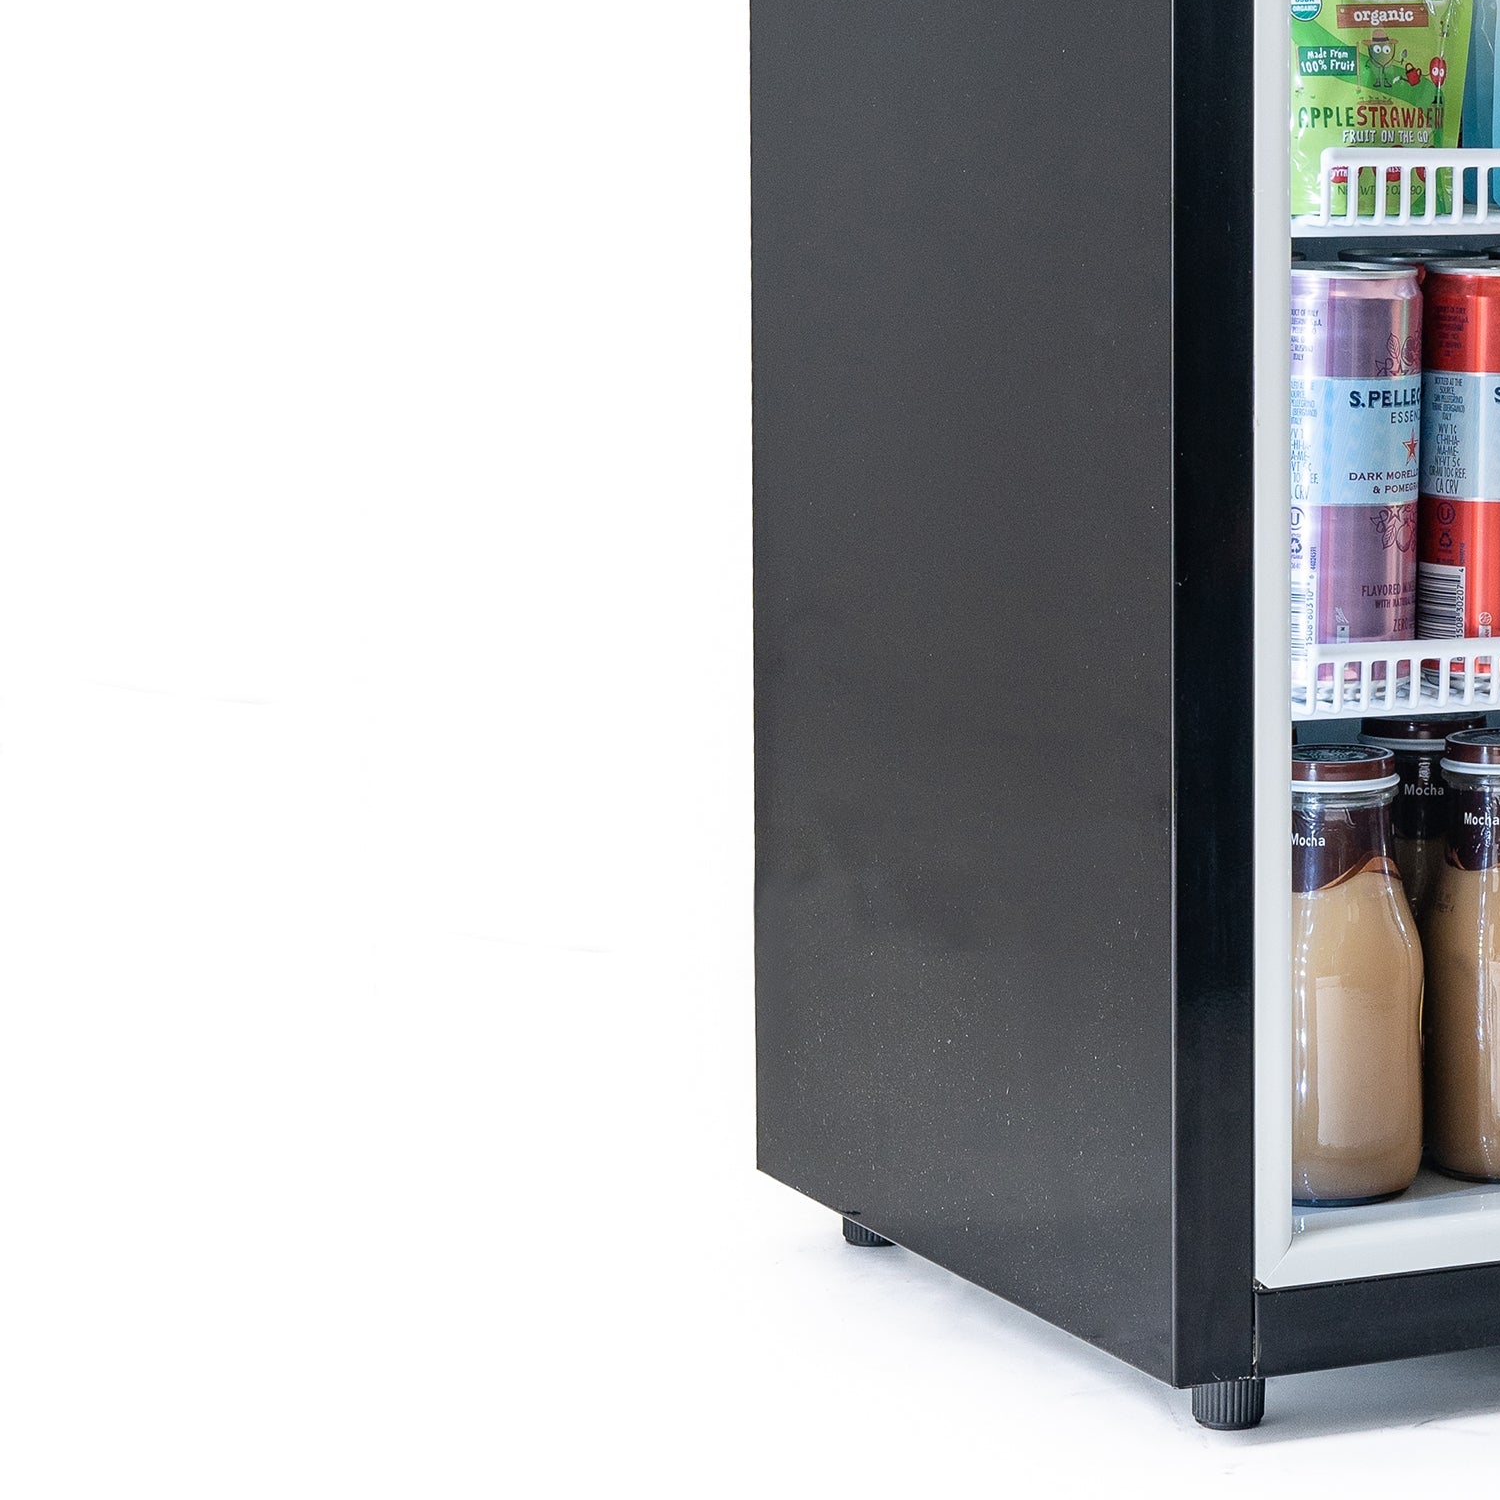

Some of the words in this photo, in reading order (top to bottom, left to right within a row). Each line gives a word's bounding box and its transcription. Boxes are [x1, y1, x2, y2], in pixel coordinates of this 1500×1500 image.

[1354, 8, 1414, 26] organic
[1308, 48, 1327, 60] Made
[1330, 49, 1348, 59] From
[1300, 60, 1327, 73] 100%
[1330, 59, 1355, 72] Fruit
[1342, 130, 1376, 144] FRUIT
[1381, 130, 1394, 143] ON
[1398, 130, 1414, 144] THE
[1417, 130, 1428, 144] GO
[1349, 472, 1382, 480] DARK
[1372, 486, 1380, 494] &
[1436, 478, 1444, 492] CA
[1446, 479, 1459, 494] CRV
[1362, 583, 1400, 596] FLAVORED
[1456, 584, 1464, 613] 30207
[1456, 616, 1464, 638] 1508
[1404, 784, 1444, 796] Mocha
[1464, 812, 1500, 826] Mocha
[1290, 833, 1326, 847] Mocha
